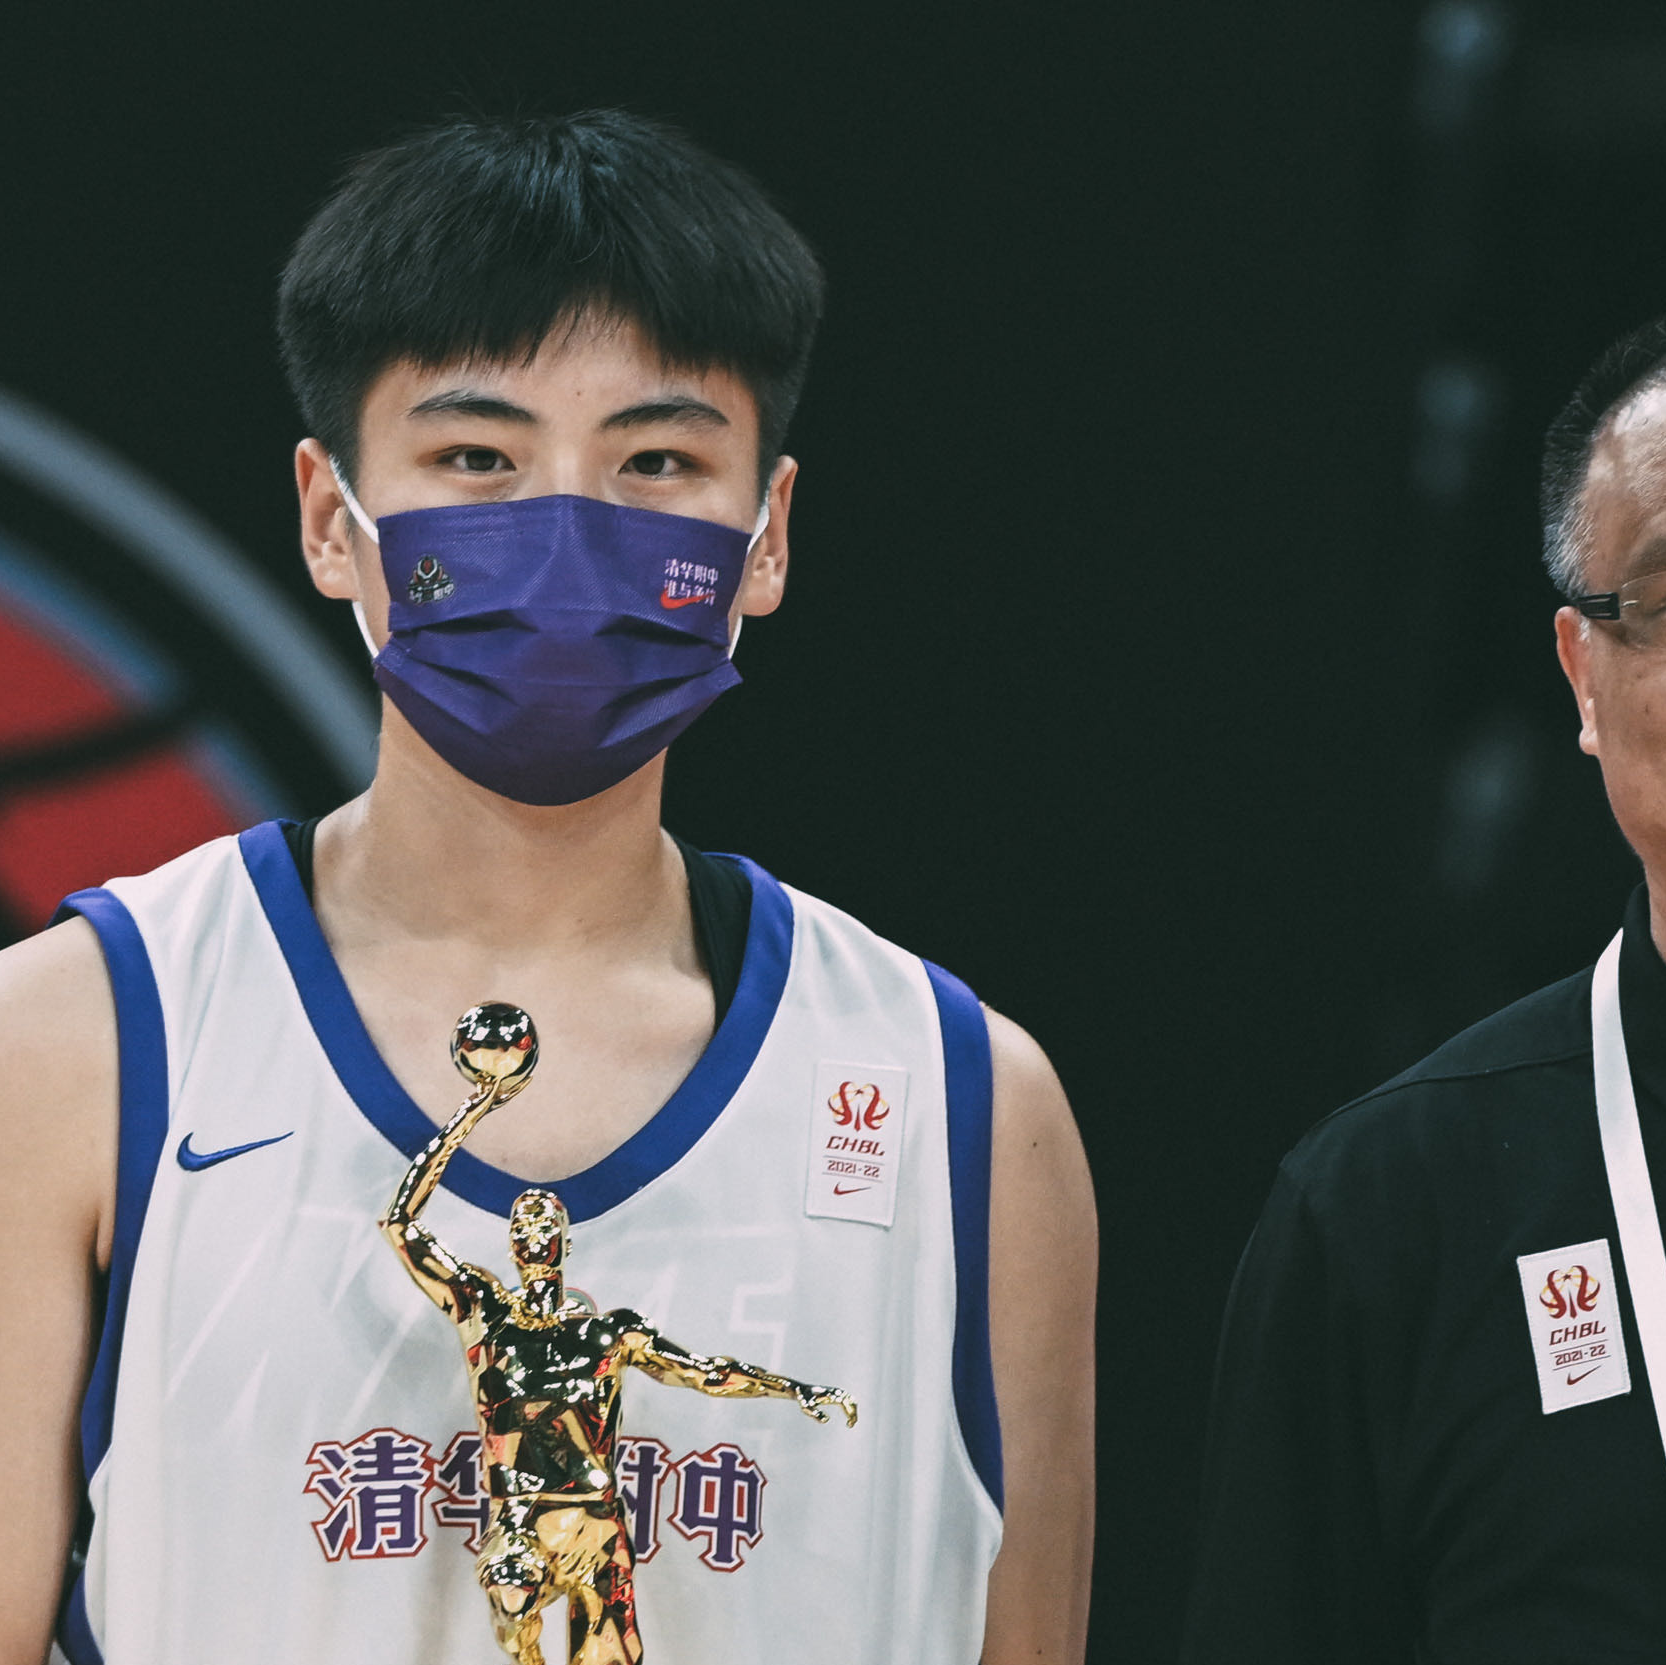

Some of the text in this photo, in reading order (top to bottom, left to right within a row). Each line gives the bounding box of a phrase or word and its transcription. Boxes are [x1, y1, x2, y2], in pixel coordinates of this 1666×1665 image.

[826, 1136, 885, 1156] CHBL
[827, 1160, 880, 1178] 2021-22
[1549, 1320, 1606, 1346] CHBL
[1555, 1344, 1606, 1366] 2021-22
